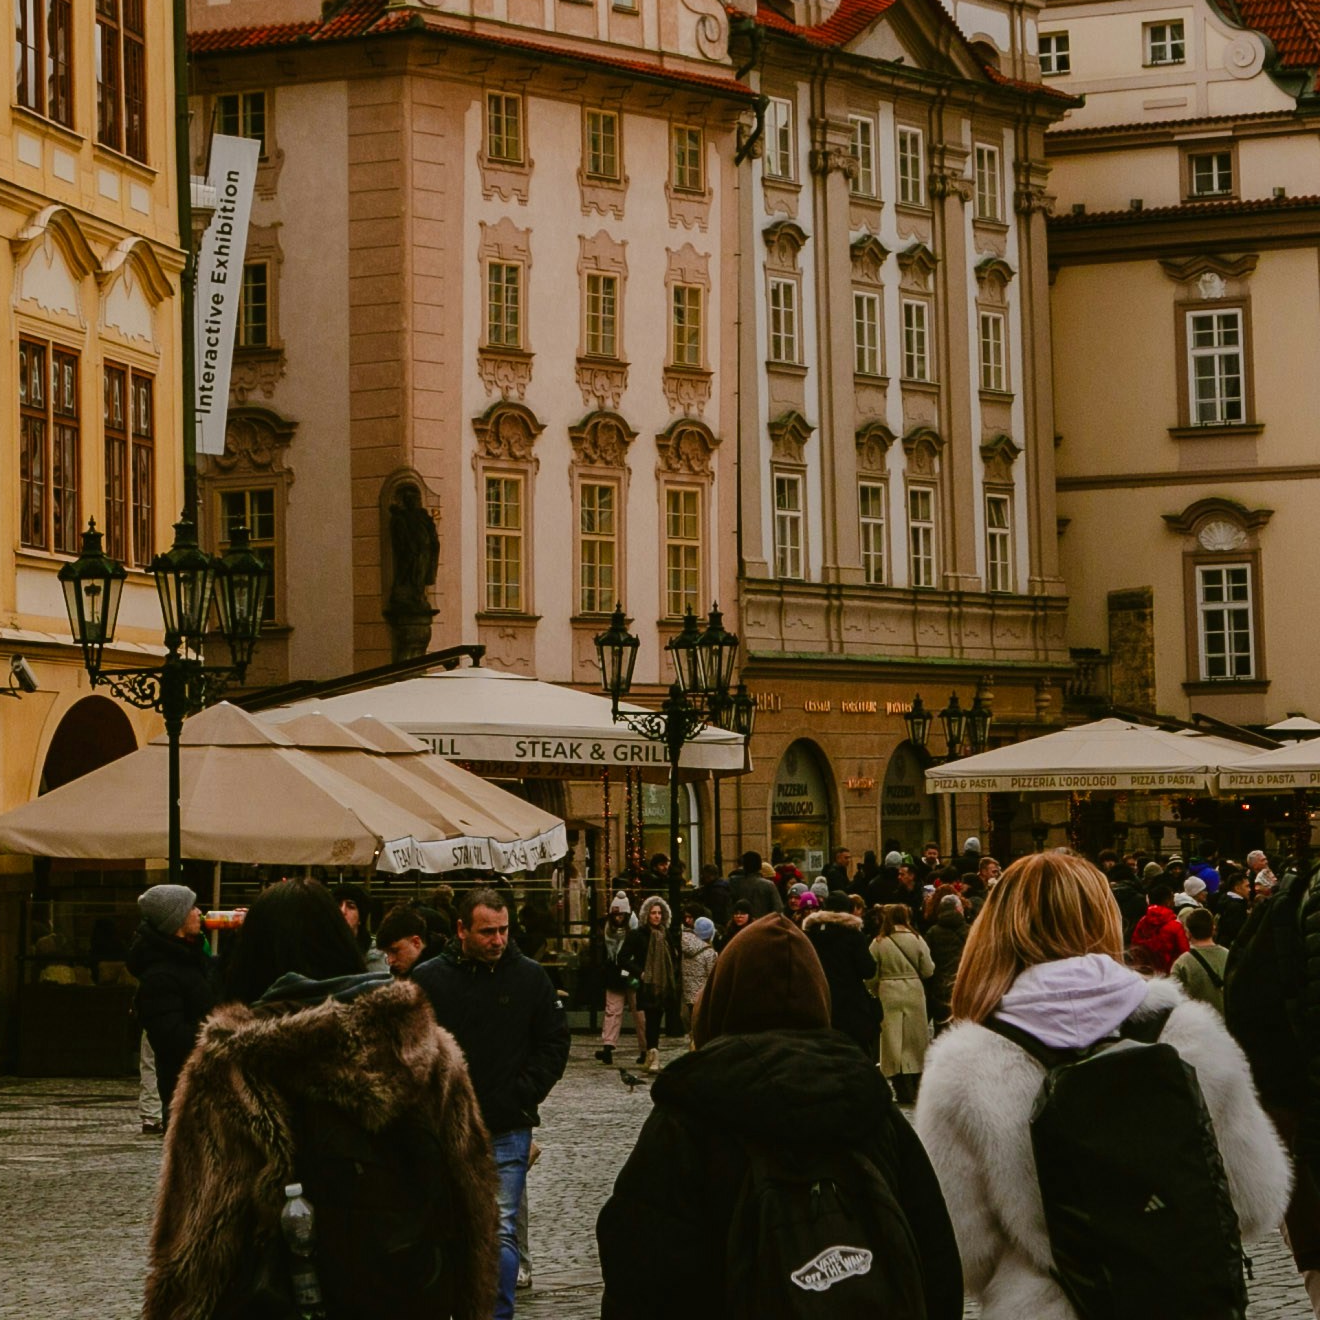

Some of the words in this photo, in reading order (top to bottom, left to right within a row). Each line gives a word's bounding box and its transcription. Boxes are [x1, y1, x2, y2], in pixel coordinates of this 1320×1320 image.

[195, 294, 224, 415] Interactive
[211, 170, 240, 284] Exhibition
[516, 741, 582, 759] STEAK
[590, 743, 605, 760] &
[934, 779, 958, 789] PIZZA
[961, 779, 966, 788] &
[970, 778, 998, 788] PASTA
[1011, 776, 1056, 788] PIZZERIA
[1059, 775, 1117, 787] L'OROLOGIO
[1131, 775, 1155, 785] PIZZA
[1159, 775, 1164, 784] &
[1167, 775, 1195, 785] PASTA
[1230, 775, 1254, 785] PIZZA
[1258, 775, 1263, 784] &
[1267, 774, 1295, 784] PASTA
[778, 783, 808, 797] PIZZERIA
[773, 801, 814, 815] L'OROLOGIO
